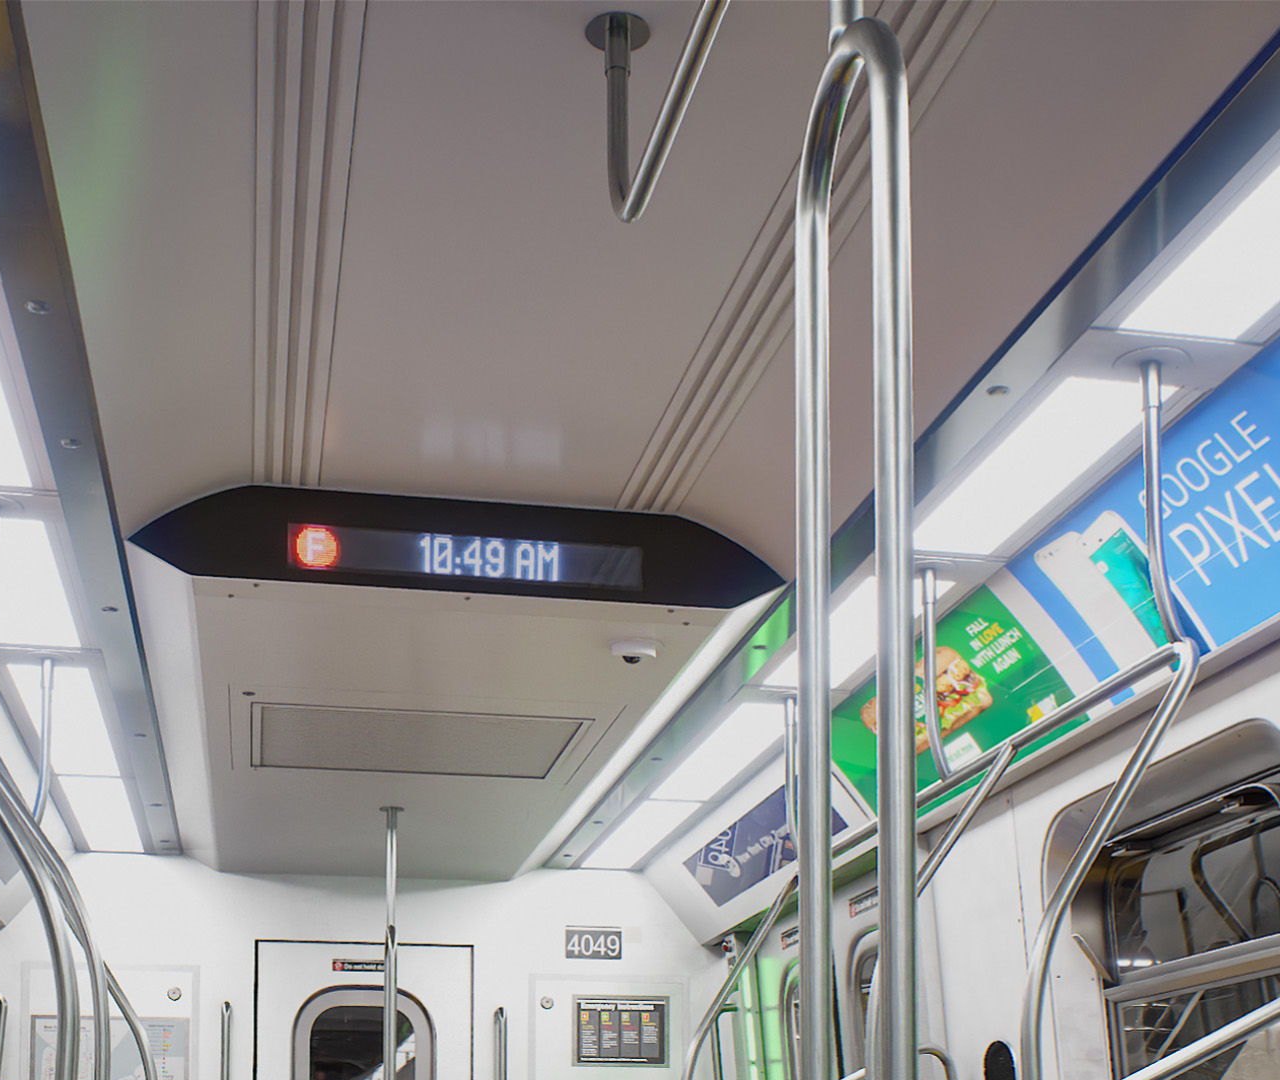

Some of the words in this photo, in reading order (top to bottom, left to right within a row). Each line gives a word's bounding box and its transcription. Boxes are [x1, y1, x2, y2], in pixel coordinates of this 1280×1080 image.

[307, 530, 327, 563] F
[419, 533, 505, 578] 10:49
[516, 540, 559, 581] AM
[966, 618, 989, 637] FALL
[969, 638, 984, 651] IN
[978, 622, 1004, 645] LOVE
[969, 647, 997, 669] WITH
[990, 627, 1023, 655] LUNCH
[992, 647, 1022, 674] AGAIN
[567, 934, 620, 956] 4049
